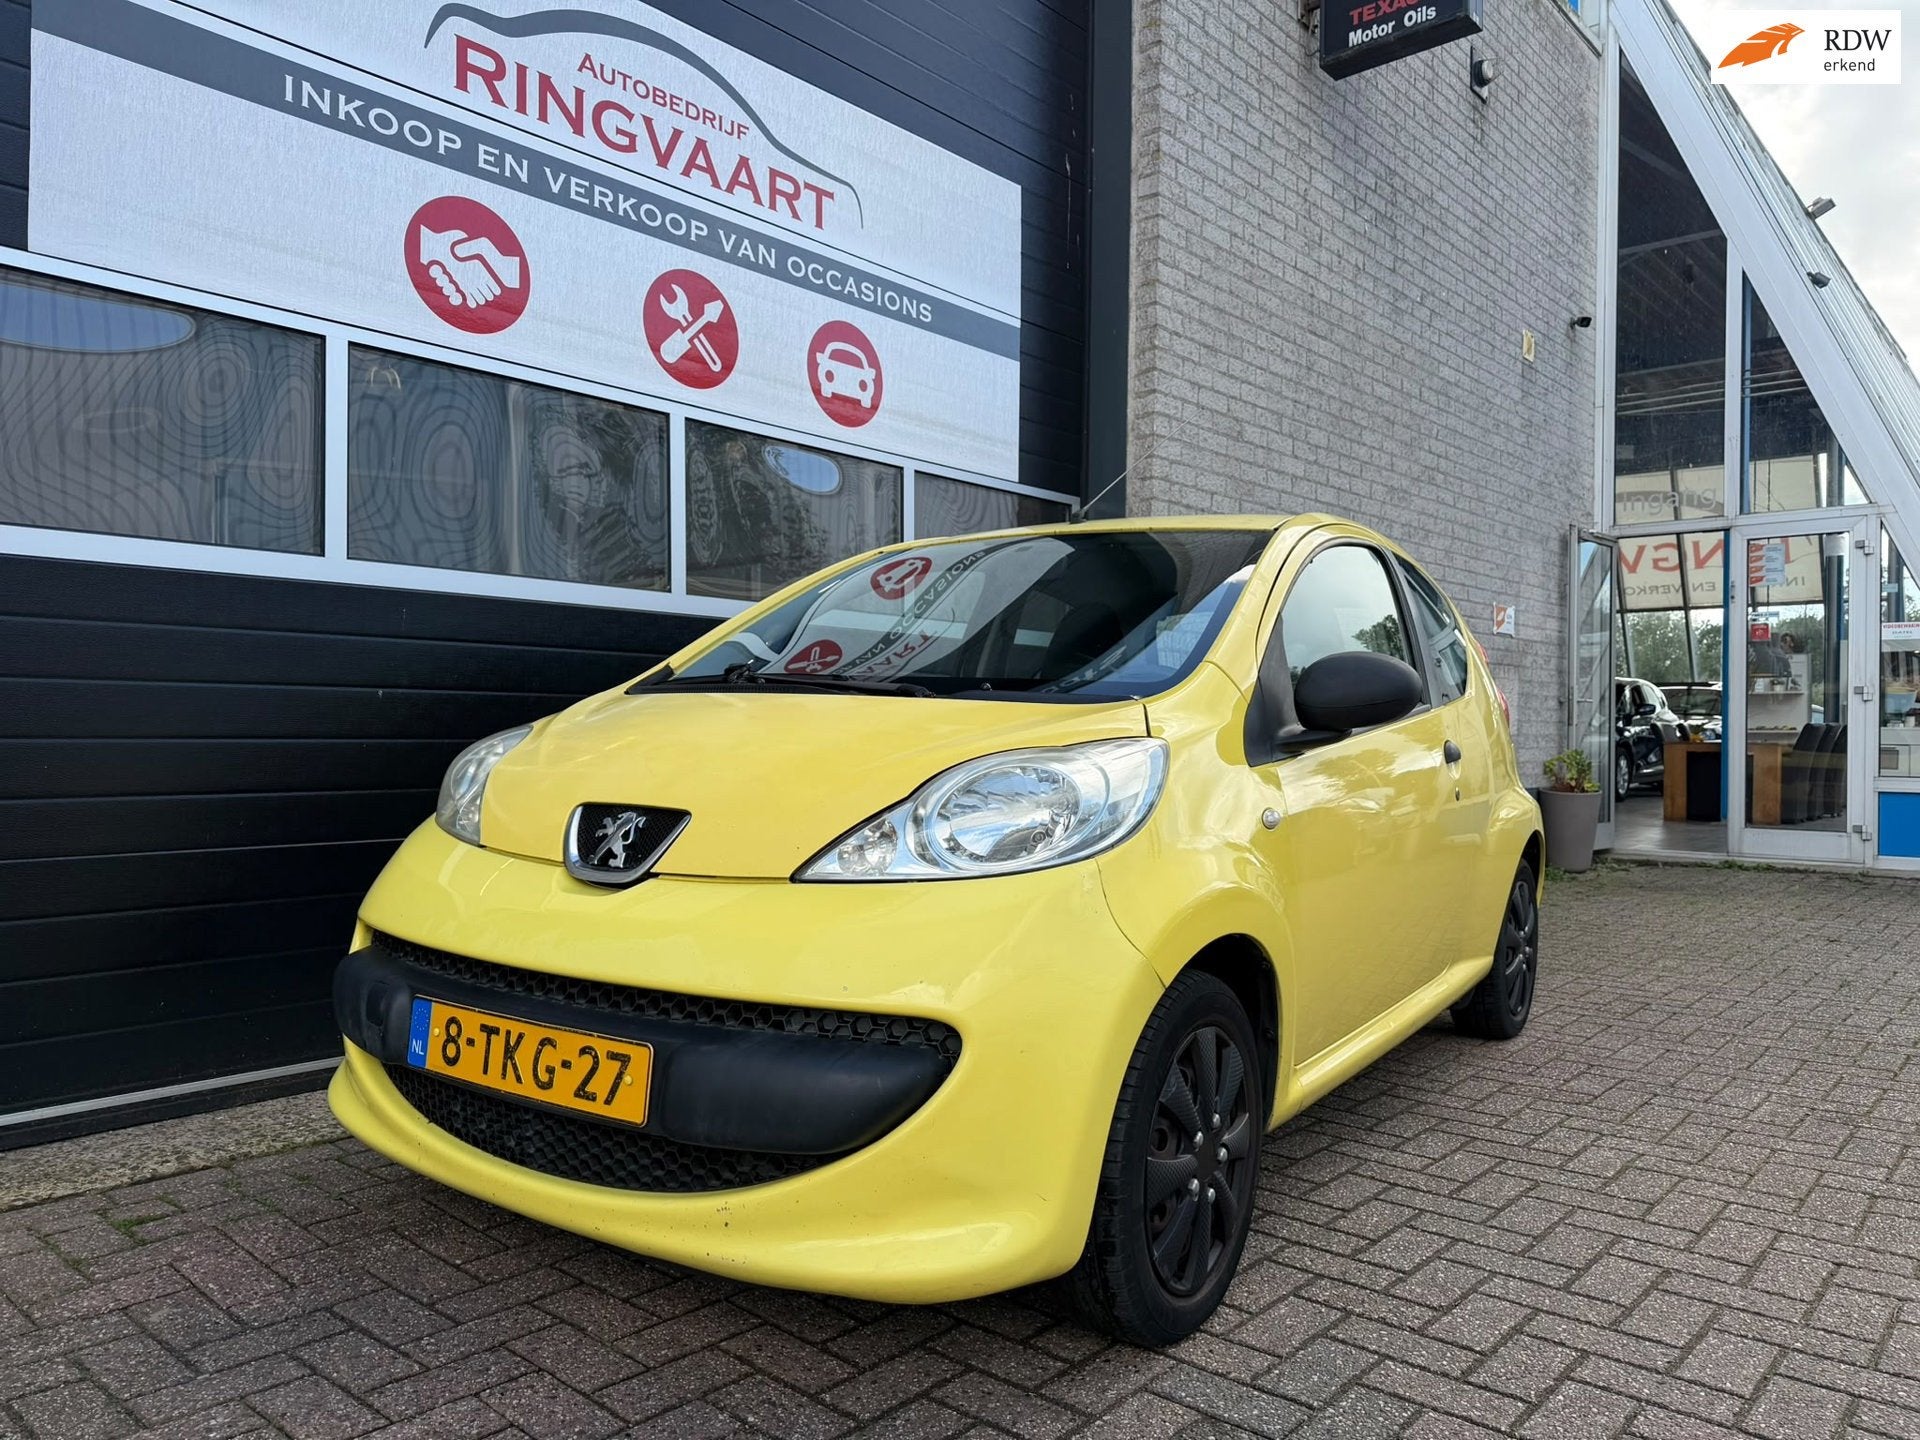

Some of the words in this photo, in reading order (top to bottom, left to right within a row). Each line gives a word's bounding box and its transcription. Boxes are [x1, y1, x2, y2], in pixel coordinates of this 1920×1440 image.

[1348, 20, 1395, 47] Motor
[1403, 6, 1437, 27] Oils
[454, 34, 834, 230] RINGVAART
[577, 52, 750, 140] AUTOBEDRIJF
[284, 74, 462, 155] INKOOP
[477, 143, 528, 184] EN
[544, 166, 708, 242] VERKOOP
[718, 229, 776, 269] VAN
[787, 256, 932, 322] OCCASIONS
[411, 1038, 425, 1056] NL
[441, 1016, 632, 1106] 8-TKG-27
